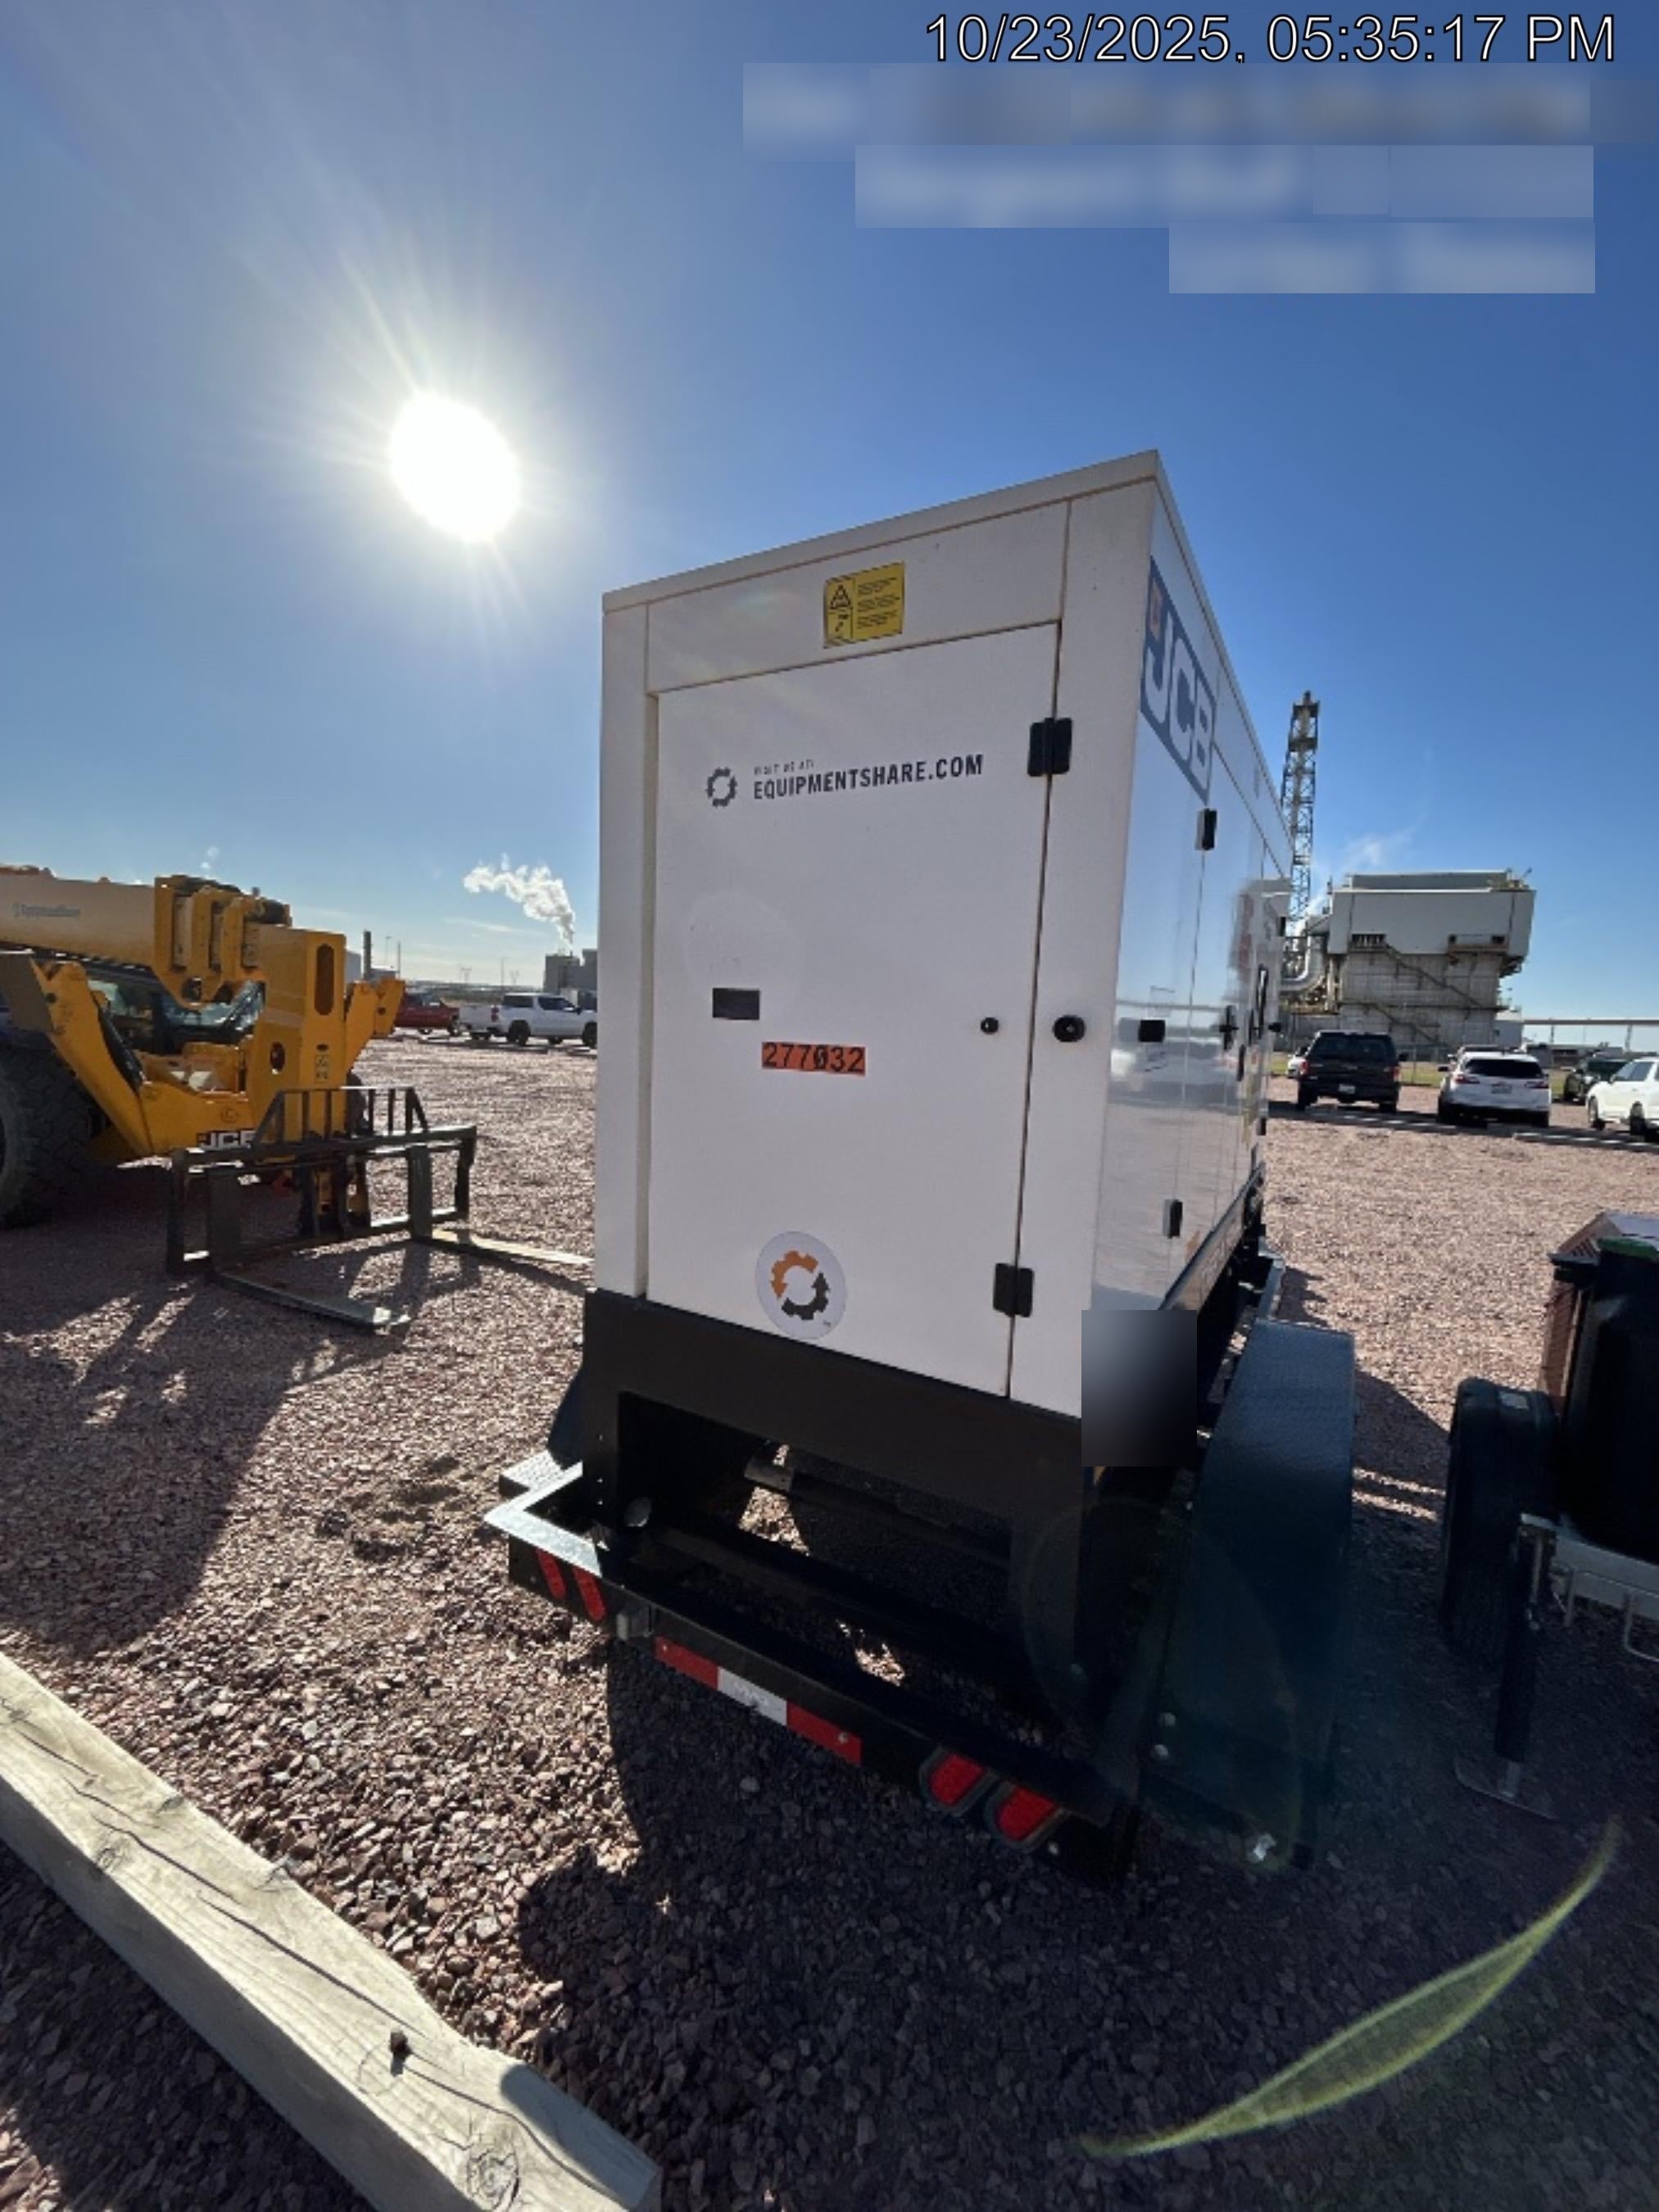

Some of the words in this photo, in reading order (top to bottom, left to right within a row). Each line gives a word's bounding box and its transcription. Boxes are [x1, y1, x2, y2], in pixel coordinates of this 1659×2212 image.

[1146, 610, 1213, 791] JCB
[753, 754, 983, 800] EQUIPMENTSHARE.COM
[763, 1042, 864, 1075] 277032
